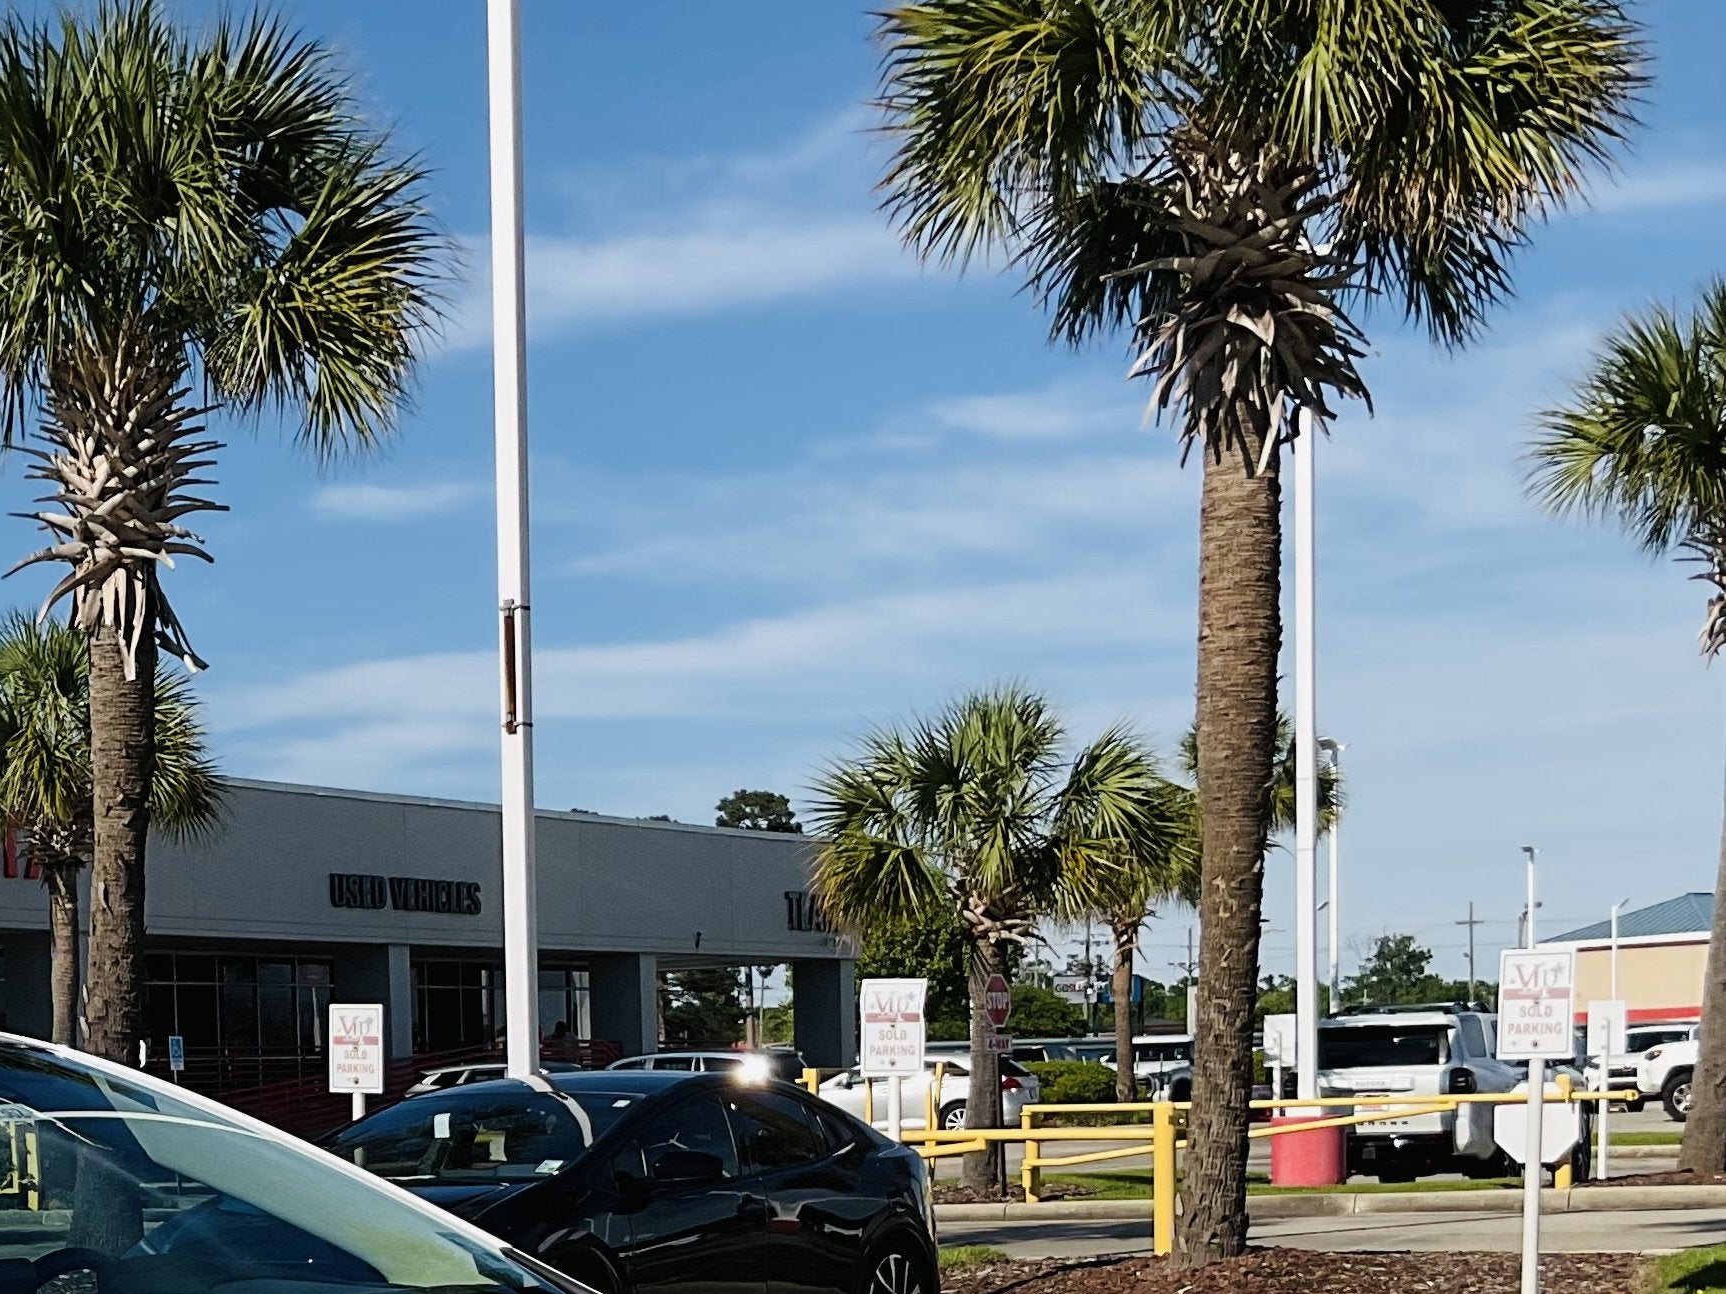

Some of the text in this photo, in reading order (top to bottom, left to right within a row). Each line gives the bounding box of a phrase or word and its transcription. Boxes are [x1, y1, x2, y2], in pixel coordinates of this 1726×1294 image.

[329, 873, 482, 915] USED VEHICLES
[987, 991, 1009, 1010] STOP
[1519, 1005, 1553, 1018] SOLD
[879, 1029, 907, 1040] SOLD
[1507, 1022, 1563, 1035] PARKING
[344, 1049, 367, 1060] SOLD
[869, 1045, 915, 1056] PARKING
[336, 1063, 374, 1074] PARKING
